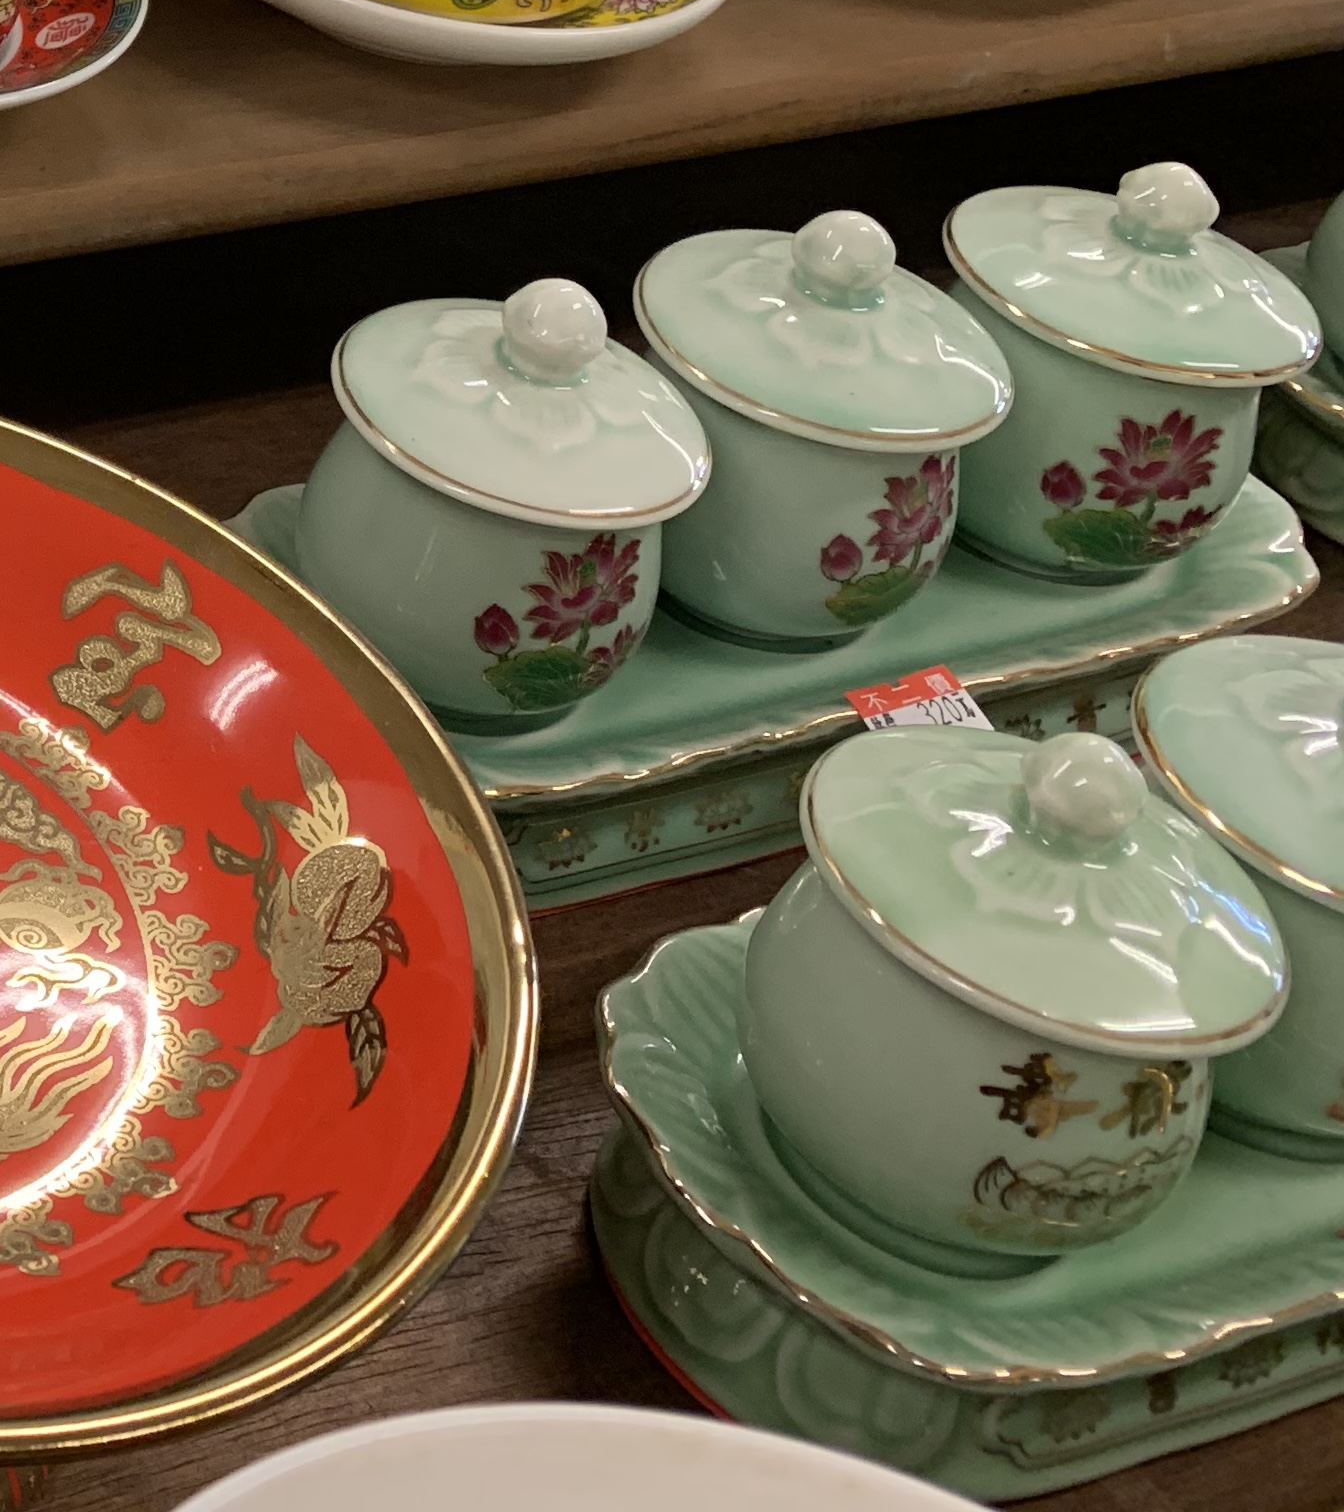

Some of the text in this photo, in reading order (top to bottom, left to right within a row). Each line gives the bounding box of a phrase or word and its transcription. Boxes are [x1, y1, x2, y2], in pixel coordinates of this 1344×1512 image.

[859, 672, 956, 713] 不二價
[916, 691, 978, 727] 320元
